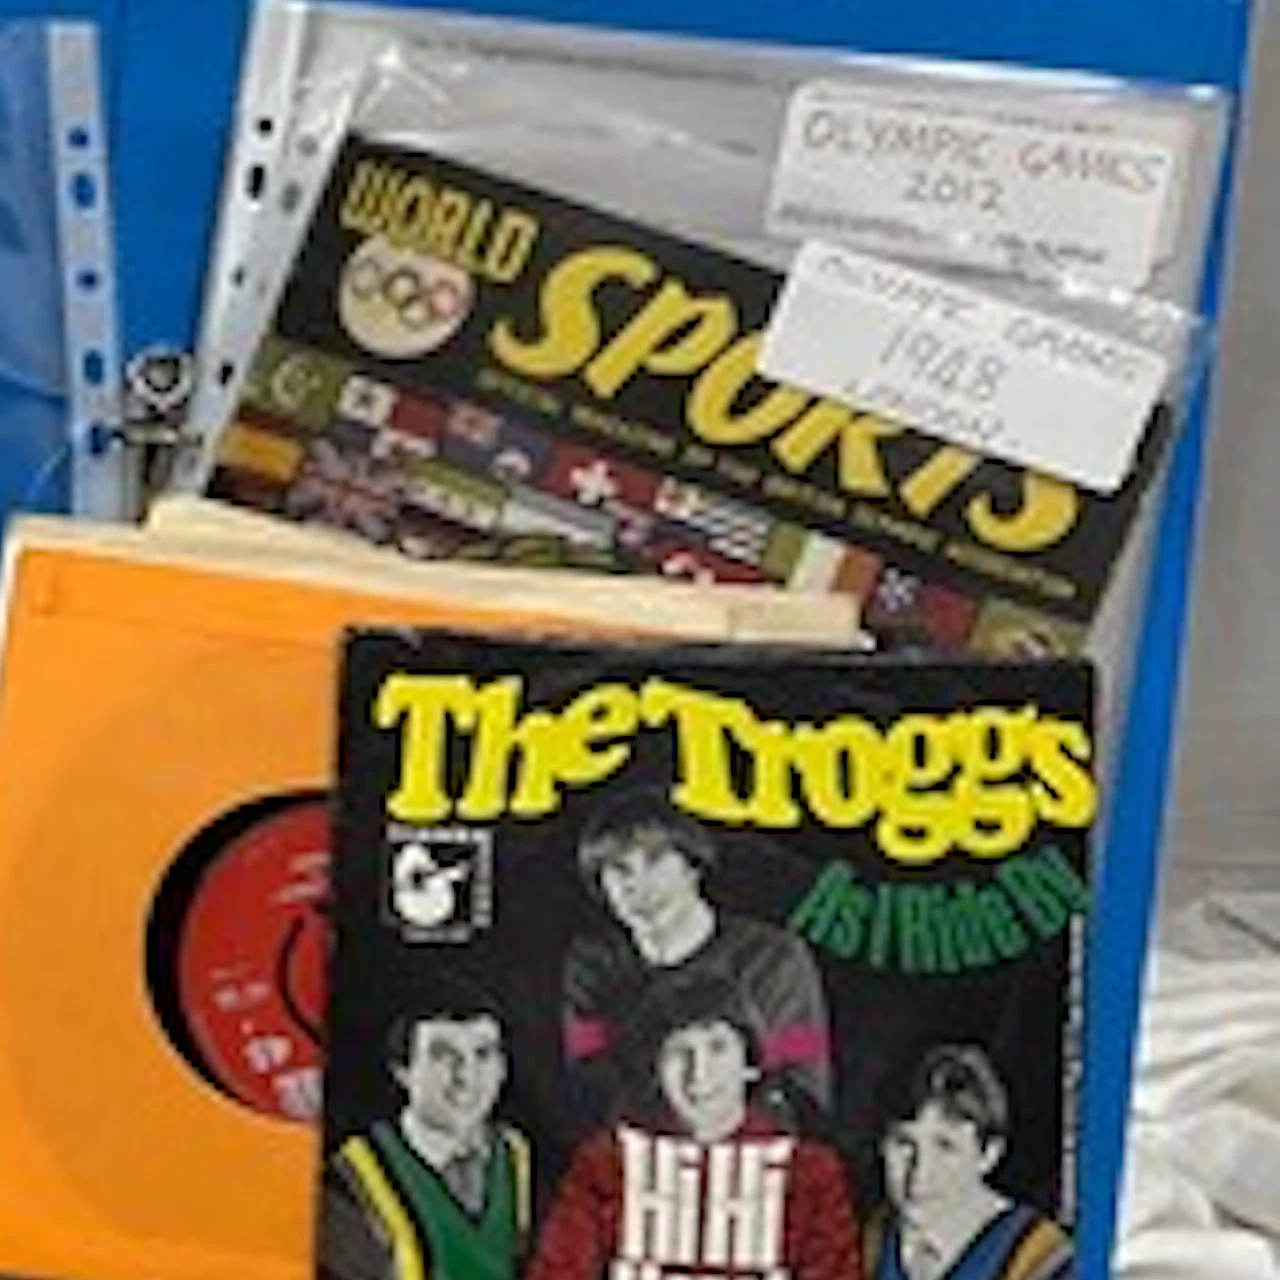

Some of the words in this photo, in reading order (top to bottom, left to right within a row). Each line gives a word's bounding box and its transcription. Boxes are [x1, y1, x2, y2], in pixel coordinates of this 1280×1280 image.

[339, 157, 542, 286] WORLD
[903, 170, 1006, 213] 2012
[880, 326, 1008, 403] 1948
[376, 671, 643, 824] The
[638, 676, 1100, 862] Troggs
[790, 859, 874, 960] As
[892, 878, 1030, 974] Ride
[615, 1125, 700, 1268] Hi
[704, 1125, 796, 1268] Hi
